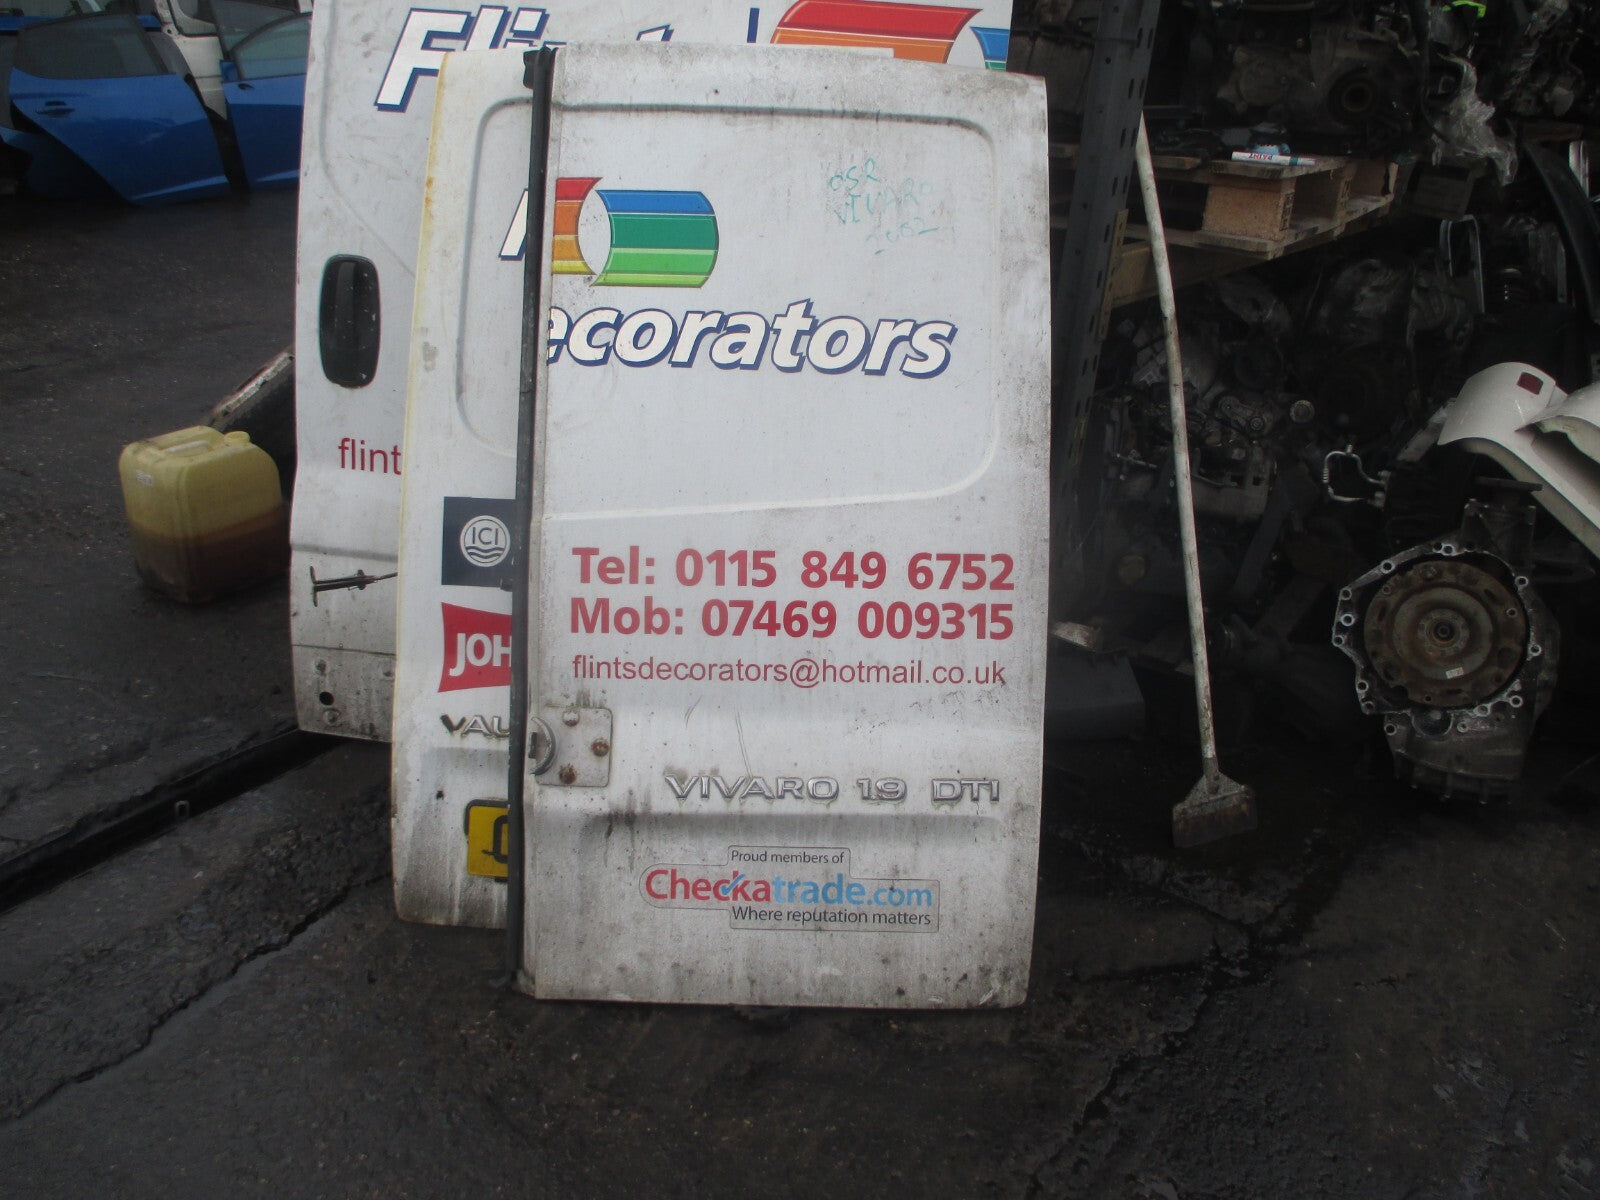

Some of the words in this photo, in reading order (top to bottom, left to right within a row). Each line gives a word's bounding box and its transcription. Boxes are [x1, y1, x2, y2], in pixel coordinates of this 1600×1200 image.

[472, 526, 499, 546] ICI
[571, 545, 655, 585] Tel:
[675, 548, 777, 588] 0115
[800, 550, 887, 590] 849
[907, 552, 1015, 591] 6752
[570, 595, 684, 635] Mob:
[701, 598, 837, 638] 07469
[857, 600, 1014, 640] 009315
[572, 654, 1006, 689] flintsdecorators@hotmail.co.uk
[664, 775, 840, 801] VIVARO
[931, 778, 1000, 802] DTI
[730, 850, 766, 864] Proud
[770, 851, 828, 864] members
[830, 852, 844, 865] of
[645, 868, 933, 907] Checkatrade.com
[731, 906, 782, 922] Where
[787, 908, 868, 925] reputation
[872, 911, 932, 926] matters
